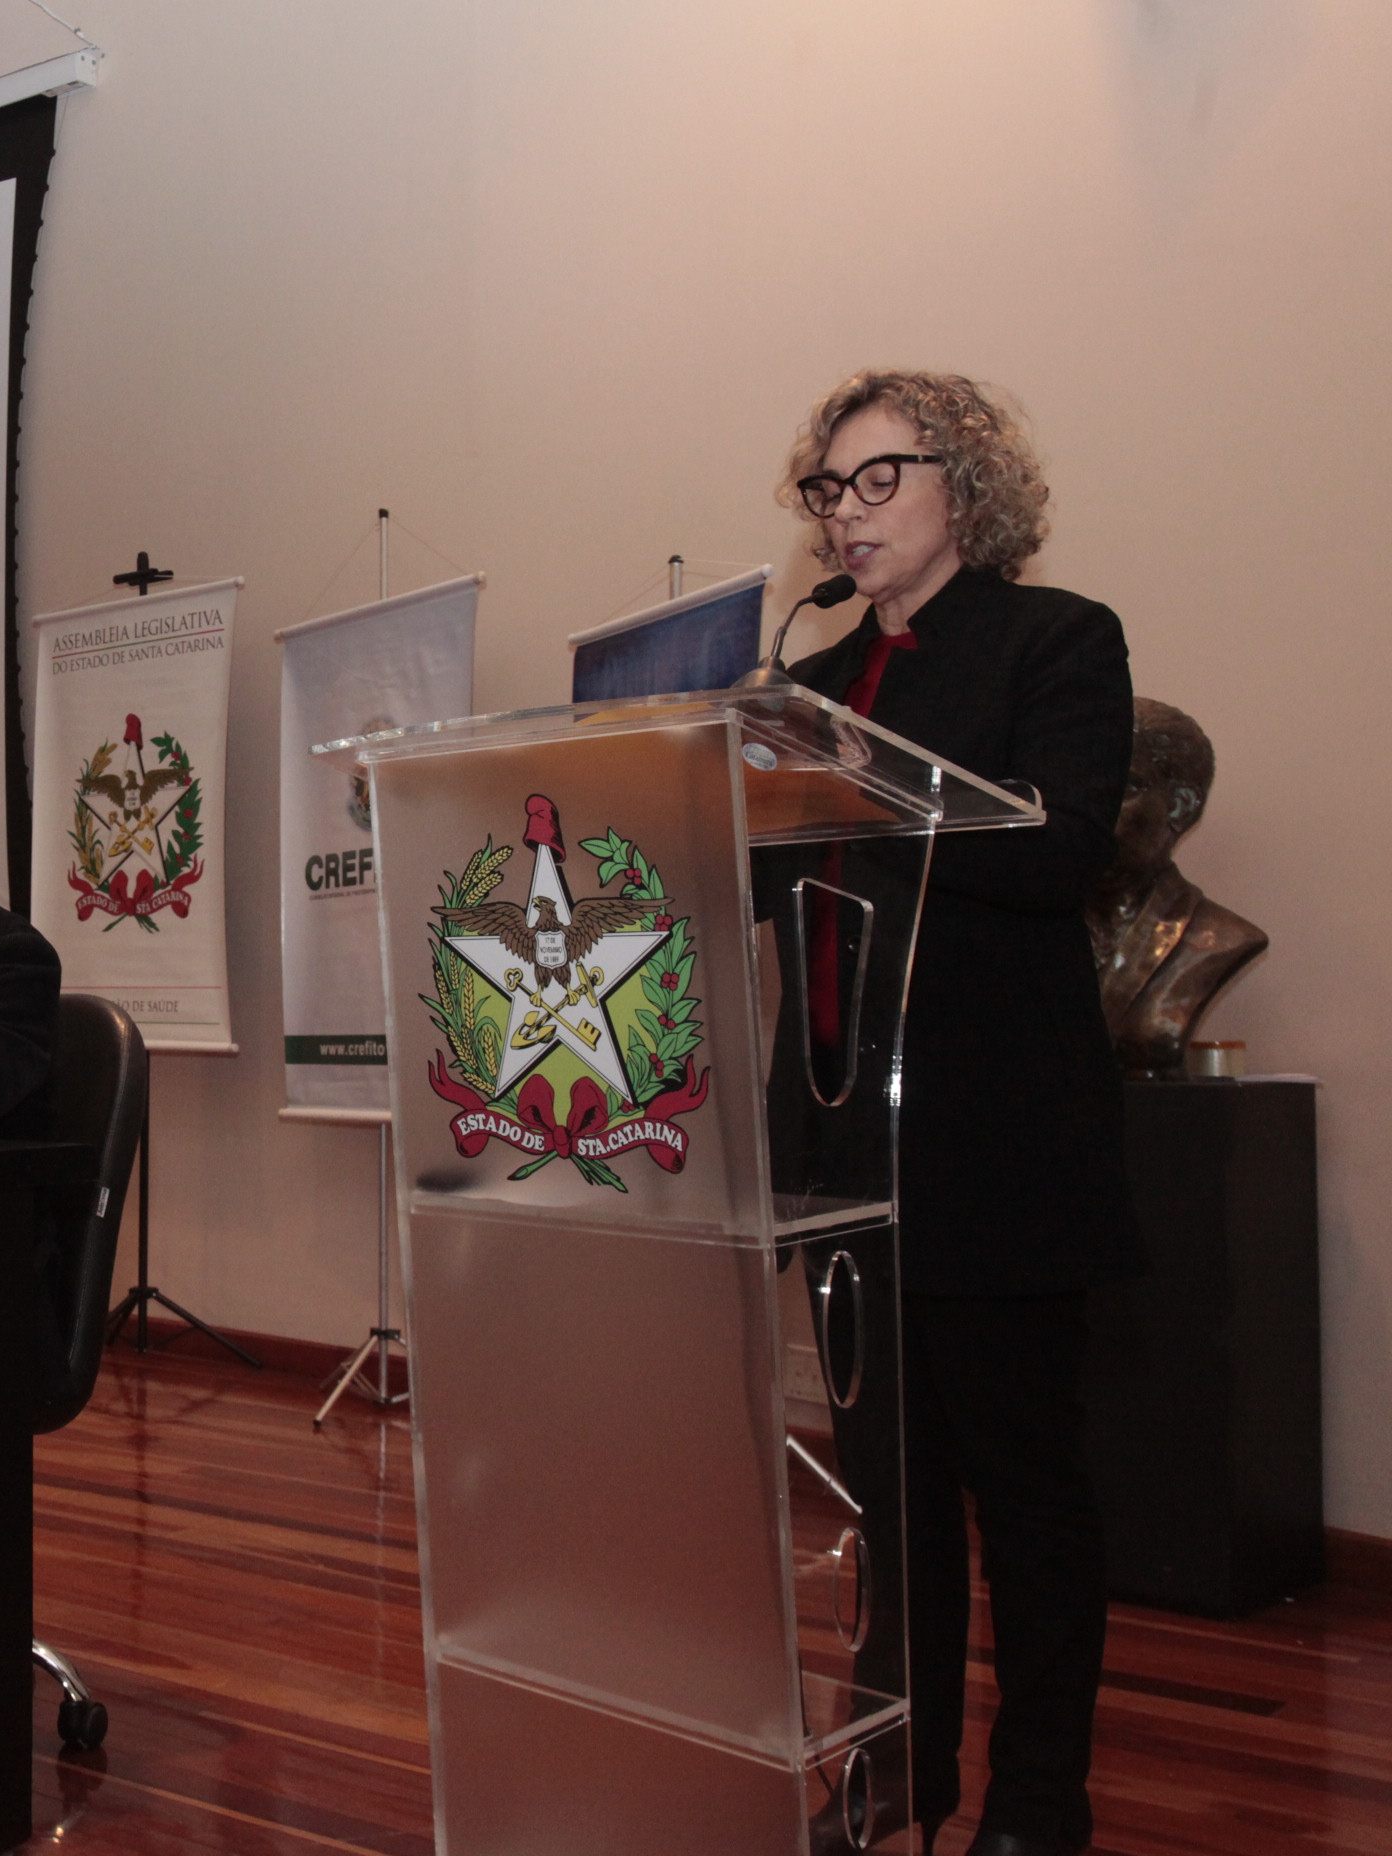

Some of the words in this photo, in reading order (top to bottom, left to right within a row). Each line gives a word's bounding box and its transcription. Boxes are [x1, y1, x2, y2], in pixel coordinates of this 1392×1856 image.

[53, 624, 130, 653] ASSEMBLEIA
[134, 608, 223, 639] LEGISLATIVA
[53, 661, 68, 675] DO
[70, 654, 110, 672] ESTADO
[112, 650, 126, 665] DE
[128, 645, 163, 662] SANTA
[165, 636, 224, 657] CATARINA
[305, 848, 376, 891] CREF
[78, 895, 108, 910] ESTADO
[132, 1001, 144, 1012] DE
[147, 998, 179, 1013] SAÚDE
[320, 1041, 385, 1056] www.crefito
[457, 1113, 522, 1141] ESTADO
[521, 1133, 545, 1151] DE
